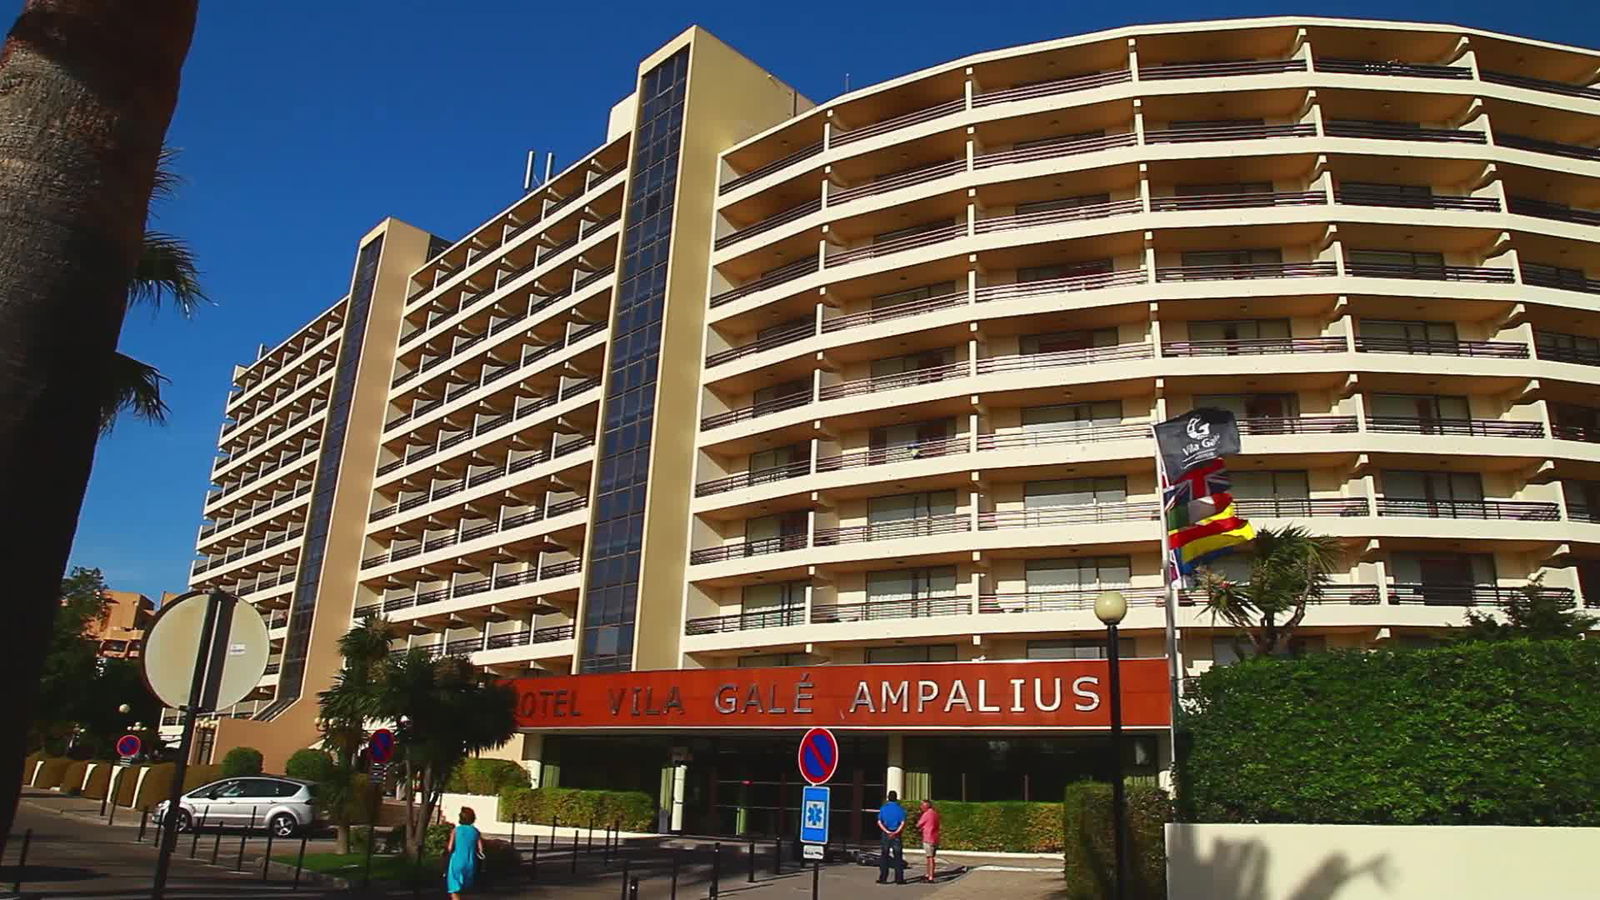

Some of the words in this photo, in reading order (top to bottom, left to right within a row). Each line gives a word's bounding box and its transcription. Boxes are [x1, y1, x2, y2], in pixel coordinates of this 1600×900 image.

[514, 690, 582, 719] OTEL
[608, 686, 685, 717] VILA
[714, 673, 815, 715] GALÉ
[849, 676, 1101, 713] AMPALIUS
